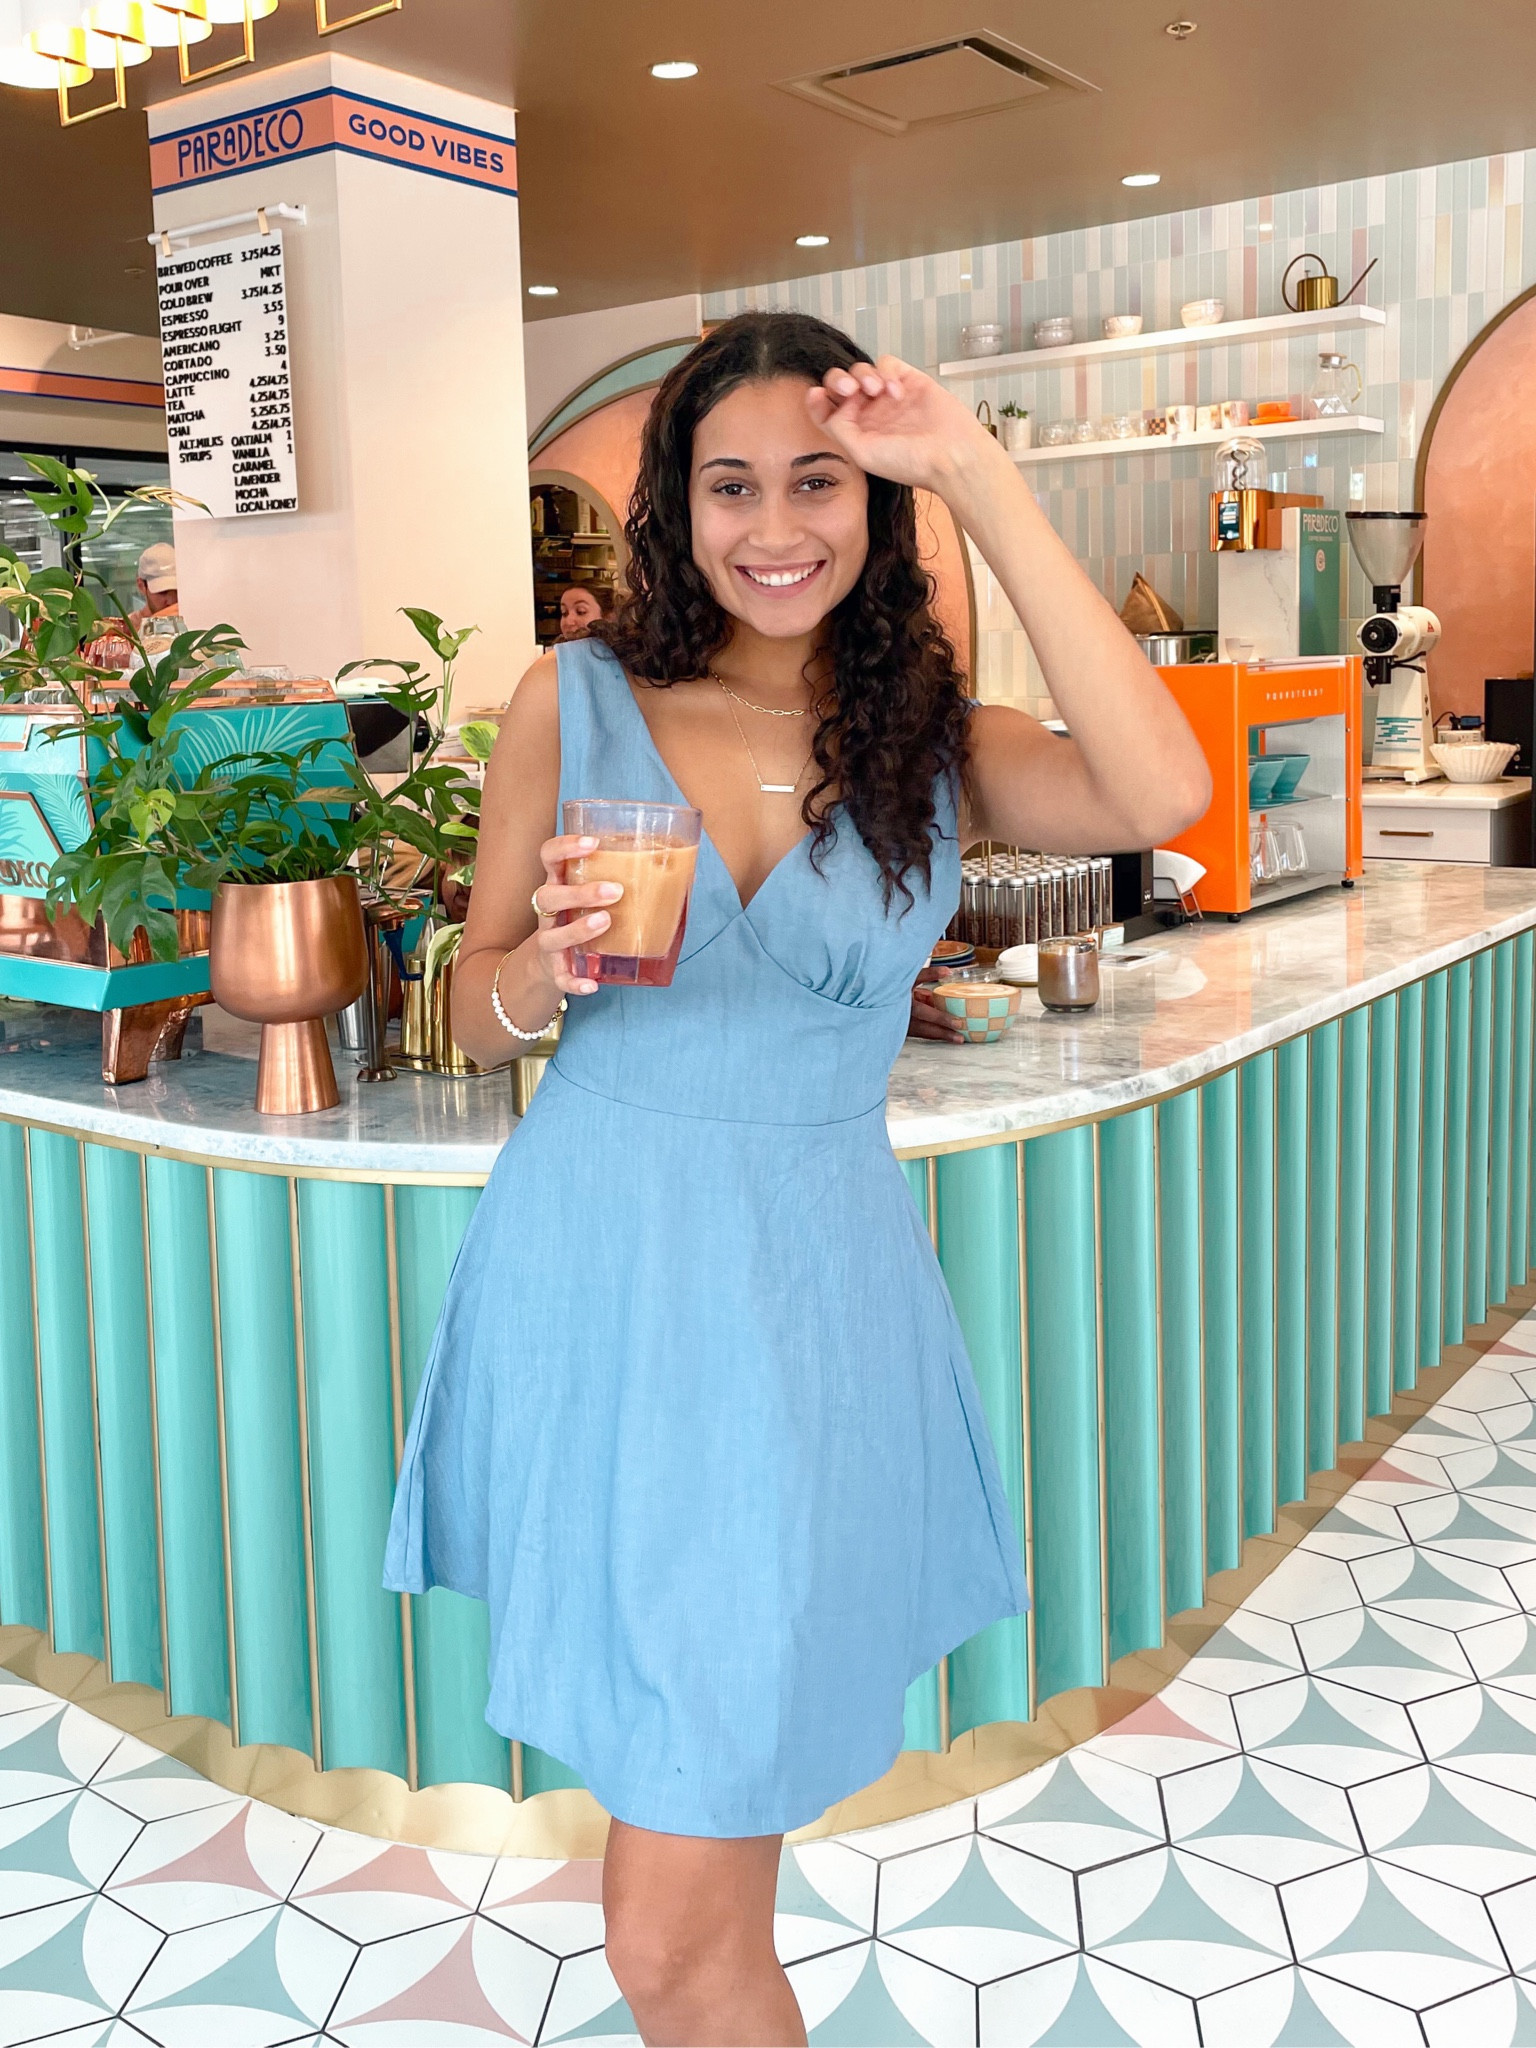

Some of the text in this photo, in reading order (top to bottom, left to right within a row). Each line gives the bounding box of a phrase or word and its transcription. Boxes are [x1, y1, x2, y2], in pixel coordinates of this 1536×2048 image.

[177, 109, 303, 178] PARADECO
[349, 113, 504, 174] GOOD VIBES
[158, 261, 196, 278] BREWED
[197, 253, 233, 270] COFFEE
[159, 265, 281, 295] POUR OVER MKT
[160, 297, 185, 311] COLD
[186, 292, 213, 306] BREW
[161, 300, 283, 326] ESPRESSO 3.55
[162, 315, 284, 342] ESPRESSO FLIGHT 9
[163, 330, 285, 358] AMERICANO 3.25
[164, 345, 286, 371] CORTADO 3.50
[165, 360, 287, 386] CAPPUCCINO 4
[166, 385, 195, 399] LATTE
[166, 400, 185, 412] TEA
[167, 410, 205, 425] MATCHA
[168, 426, 190, 437] CHAI
[286, 430, 292, 440] 1
[179, 444, 293, 463] SYRUPS VANILLA 1
[232, 459, 276, 473] CARAMEL
[234, 473, 281, 486] LAVENDER
[235, 487, 269, 500] MOCHA
